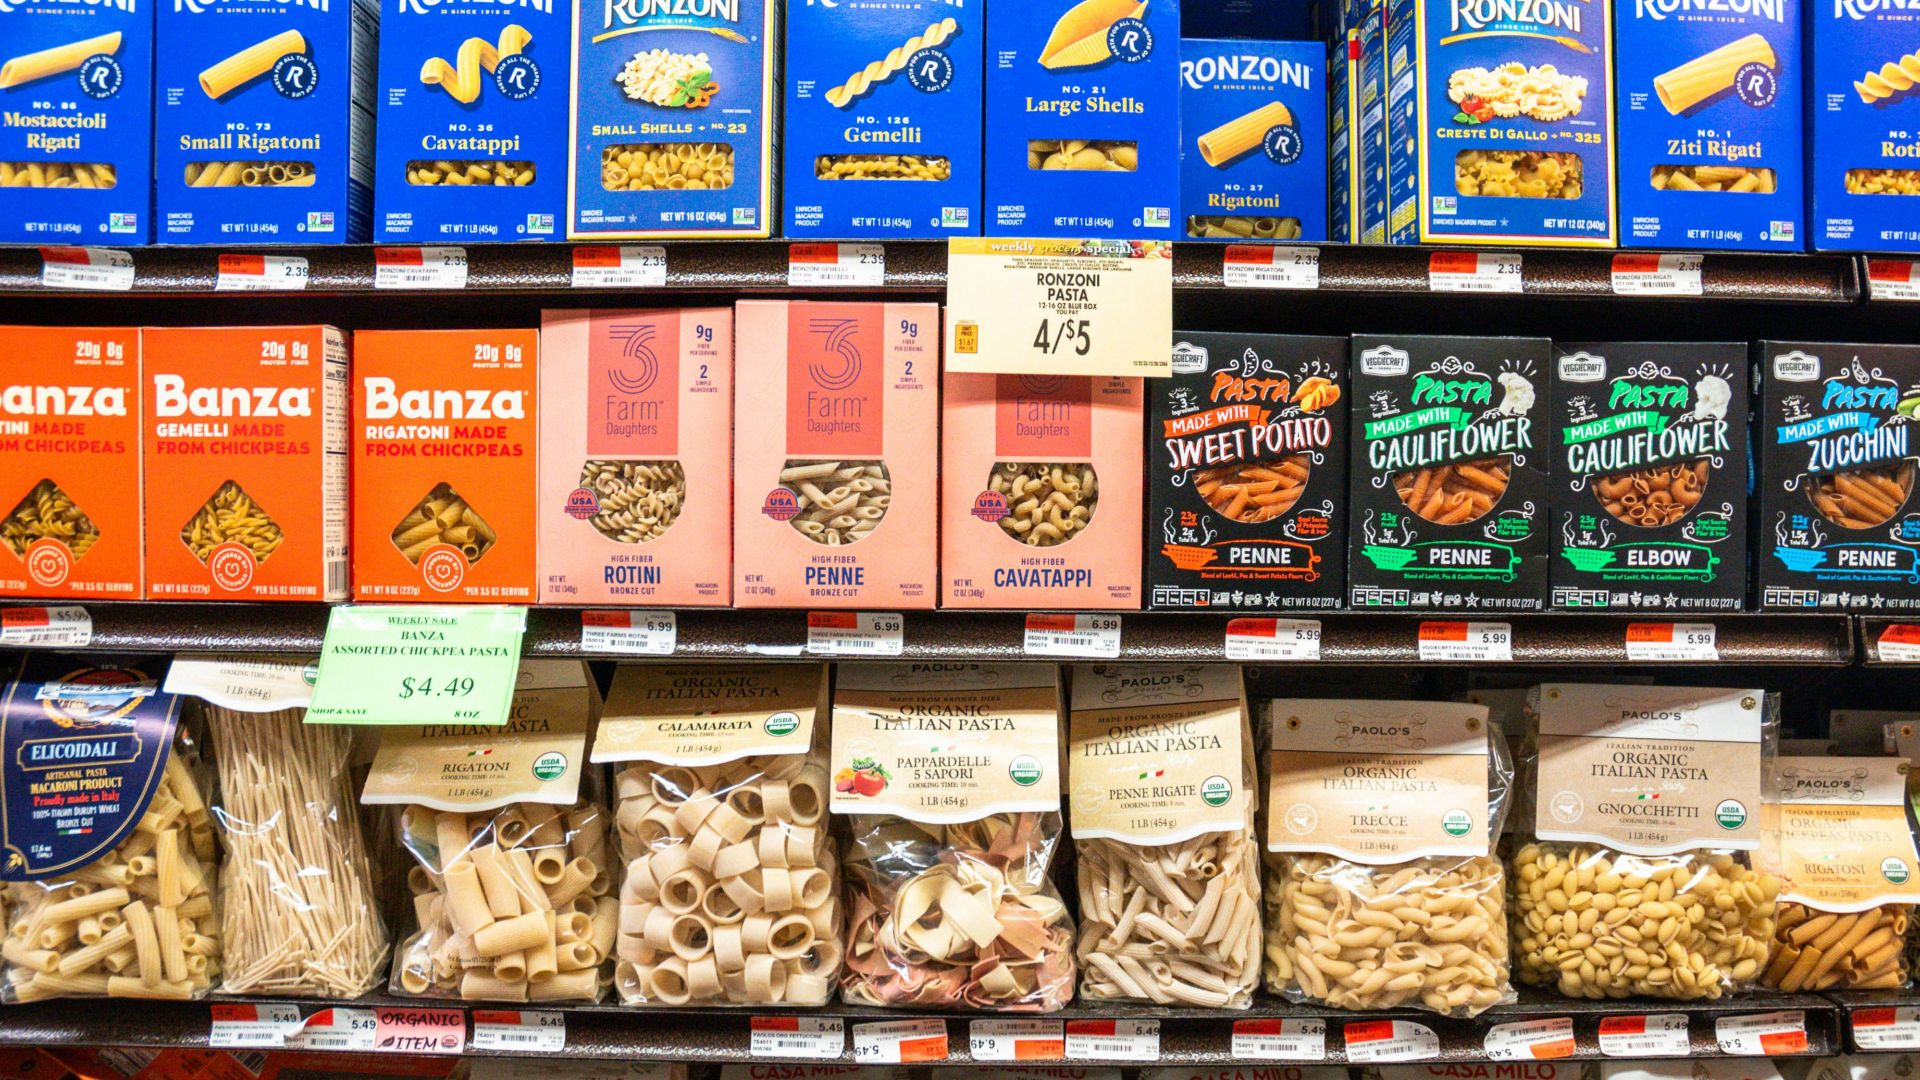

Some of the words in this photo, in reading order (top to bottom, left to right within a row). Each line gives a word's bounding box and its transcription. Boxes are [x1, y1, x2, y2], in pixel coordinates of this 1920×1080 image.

[1450, 0, 1581, 33] RONZONI
[1180, 56, 1311, 90] RONZONI
[1026, 97, 1081, 115] Large
[1086, 97, 1144, 113] Shells
[4, 112, 107, 129] Mostaccioli
[592, 124, 636, 135] SMALL
[641, 122, 693, 133] SHELLS
[727, 123, 747, 134] 23
[27, 134, 80, 152] Rigati
[844, 127, 922, 143] Gemelli
[1437, 128, 1486, 139] CRESTE
[1491, 128, 1503, 139] DI
[1507, 129, 1548, 140] GALLO
[1575, 133, 1601, 144] 325
[180, 135, 232, 150] Small
[238, 134, 321, 153] Rigatoni
[422, 135, 520, 155] Cavatappi
[1667, 140, 1702, 156] Ziti
[1707, 140, 1761, 161] Rigati
[1208, 193, 1280, 211] Rigatoni
[661, 212, 675, 221] NET
[677, 212, 688, 221] WT
[689, 212, 694, 221] 16
[696, 212, 704, 221] OZ
[706, 212, 727, 223] (454g)
[992, 242, 1034, 254] weekly
[643, 256, 666, 266] 2.39
[861, 254, 884, 264] 2.39
[1037, 273, 1100, 287] RONZONI
[696, 325, 712, 341] 9g
[901, 320, 918, 338] 9g
[1034, 318, 1090, 355] 4/$5
[262, 342, 286, 358] 20g
[292, 342, 309, 359] 8g
[475, 345, 499, 362] 20g
[505, 345, 522, 362] 8g
[1365, 358, 1404, 366] VEGGIECRAFT
[1563, 362, 1602, 372] VEGGIECRAFT
[1210, 371, 1290, 402] PASTA
[1411, 374, 1492, 405] PASTA
[1821, 380, 1899, 409] PASTA
[0, 386, 127, 416] anza
[154, 374, 311, 416] Banza
[364, 377, 524, 419] Banza
[607, 396, 658, 420] Farm
[807, 392, 861, 417] Farm
[807, 419, 861, 435] Daughters
[1172, 417, 1213, 433] MADE
[1217, 406, 1248, 421] WITH
[1373, 417, 1414, 435] MADE
[1418, 407, 1449, 425] WITH
[157, 423, 228, 437] GEMELLI
[233, 424, 285, 437] MADE
[366, 425, 449, 439] RIGATONI
[454, 426, 506, 439] MADE
[606, 422, 657, 438] Daughters
[1016, 422, 1070, 438] Daughters
[157, 441, 205, 454] FROM
[210, 441, 310, 454] CHICKPEAS
[366, 444, 416, 456] FROM
[422, 444, 523, 457] CHICKPEAS
[1165, 429, 1247, 471] SWEET
[1251, 418, 1331, 457] POTATO
[1369, 417, 1532, 469] CAULIFLOWER
[1568, 420, 1730, 473] CAULIFLOWER
[1807, 425, 1909, 472] ZUCCHINI
[572, 498, 592, 506] USA
[770, 498, 792, 507] USA
[1230, 547, 1291, 563] PENNE
[1430, 549, 1491, 565] PENNE
[1627, 550, 1691, 566] ELBOW
[605, 566, 661, 584] ROTINI
[805, 567, 864, 585] PENNE
[994, 569, 1092, 587] CAVATAPPI
[810, 588, 838, 596] BRONZE
[388, 616, 428, 625] WEEKLY
[432, 617, 458, 625] SALE
[648, 622, 672, 631] 6.99
[874, 622, 899, 631] 6.99
[401, 631, 445, 641] BANZA
[1483, 634, 1506, 643] 5.99
[1688, 635, 1711, 644] 5.99
[332, 646, 397, 656] ASSORTED
[400, 646, 465, 656] CHICKPEA
[470, 648, 508, 656] PASTA
[400, 676, 474, 699] $4.49
[900, 705, 989, 716] ORGANIC
[1622, 710, 1682, 721] PAOLO'S
[658, 721, 752, 731] CALAMARATA
[1352, 726, 1410, 735] PAOLO'S
[31, 742, 116, 760] ELICOIDALI
[1613, 752, 1688, 766] ORGANIC
[442, 762, 510, 772] RIGATONI
[897, 756, 991, 768] PAPPARDELLE
[914, 769, 920, 779] 5
[925, 768, 973, 779] SAPORI
[1592, 764, 1656, 779] ITALIAN
[1661, 767, 1709, 781] PASTA
[30, 779, 78, 794] MACARONI
[80, 777, 123, 790] PRODUCT
[1797, 780, 1850, 788] PAOLO'S
[34, 794, 64, 806] Proudly
[67, 792, 89, 803] made
[91, 792, 99, 801] in
[101, 791, 119, 801] Italy
[1109, 788, 1148, 800] PENNE
[1152, 785, 1196, 797] RIGATE
[1598, 803, 1699, 818] GNOCCHETTI
[1350, 815, 1408, 826] TRECCE
[1805, 864, 1865, 874] RIGATONI
[274, 1014, 296, 1023] 5.49
[352, 1020, 376, 1030] 5.49
[382, 1013, 460, 1026] ORGANIC
[395, 1036, 437, 1050] ITEM
[971, 1039, 995, 1050] 6.49
[1495, 1065, 1555, 1078] MILO
